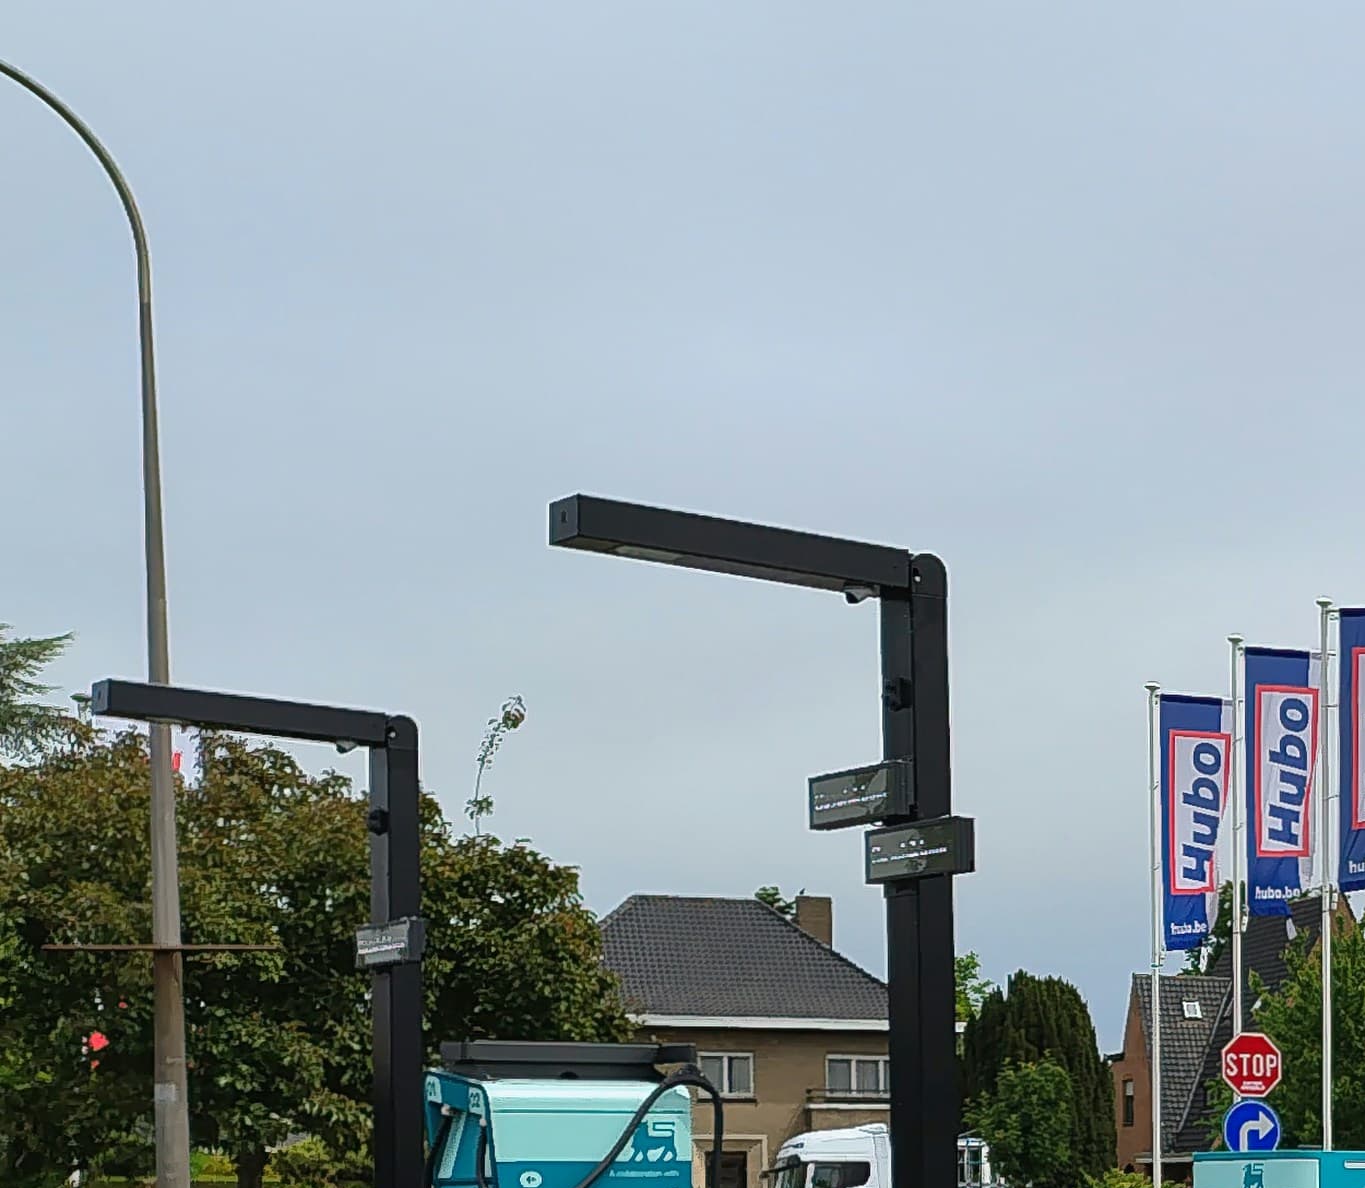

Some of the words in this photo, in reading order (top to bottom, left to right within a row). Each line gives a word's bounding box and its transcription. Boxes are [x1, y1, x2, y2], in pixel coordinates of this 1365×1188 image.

[1182, 742, 1221, 883] Hubo
[1269, 697, 1310, 846] Hubo
[1226, 1053, 1277, 1077] STOP
